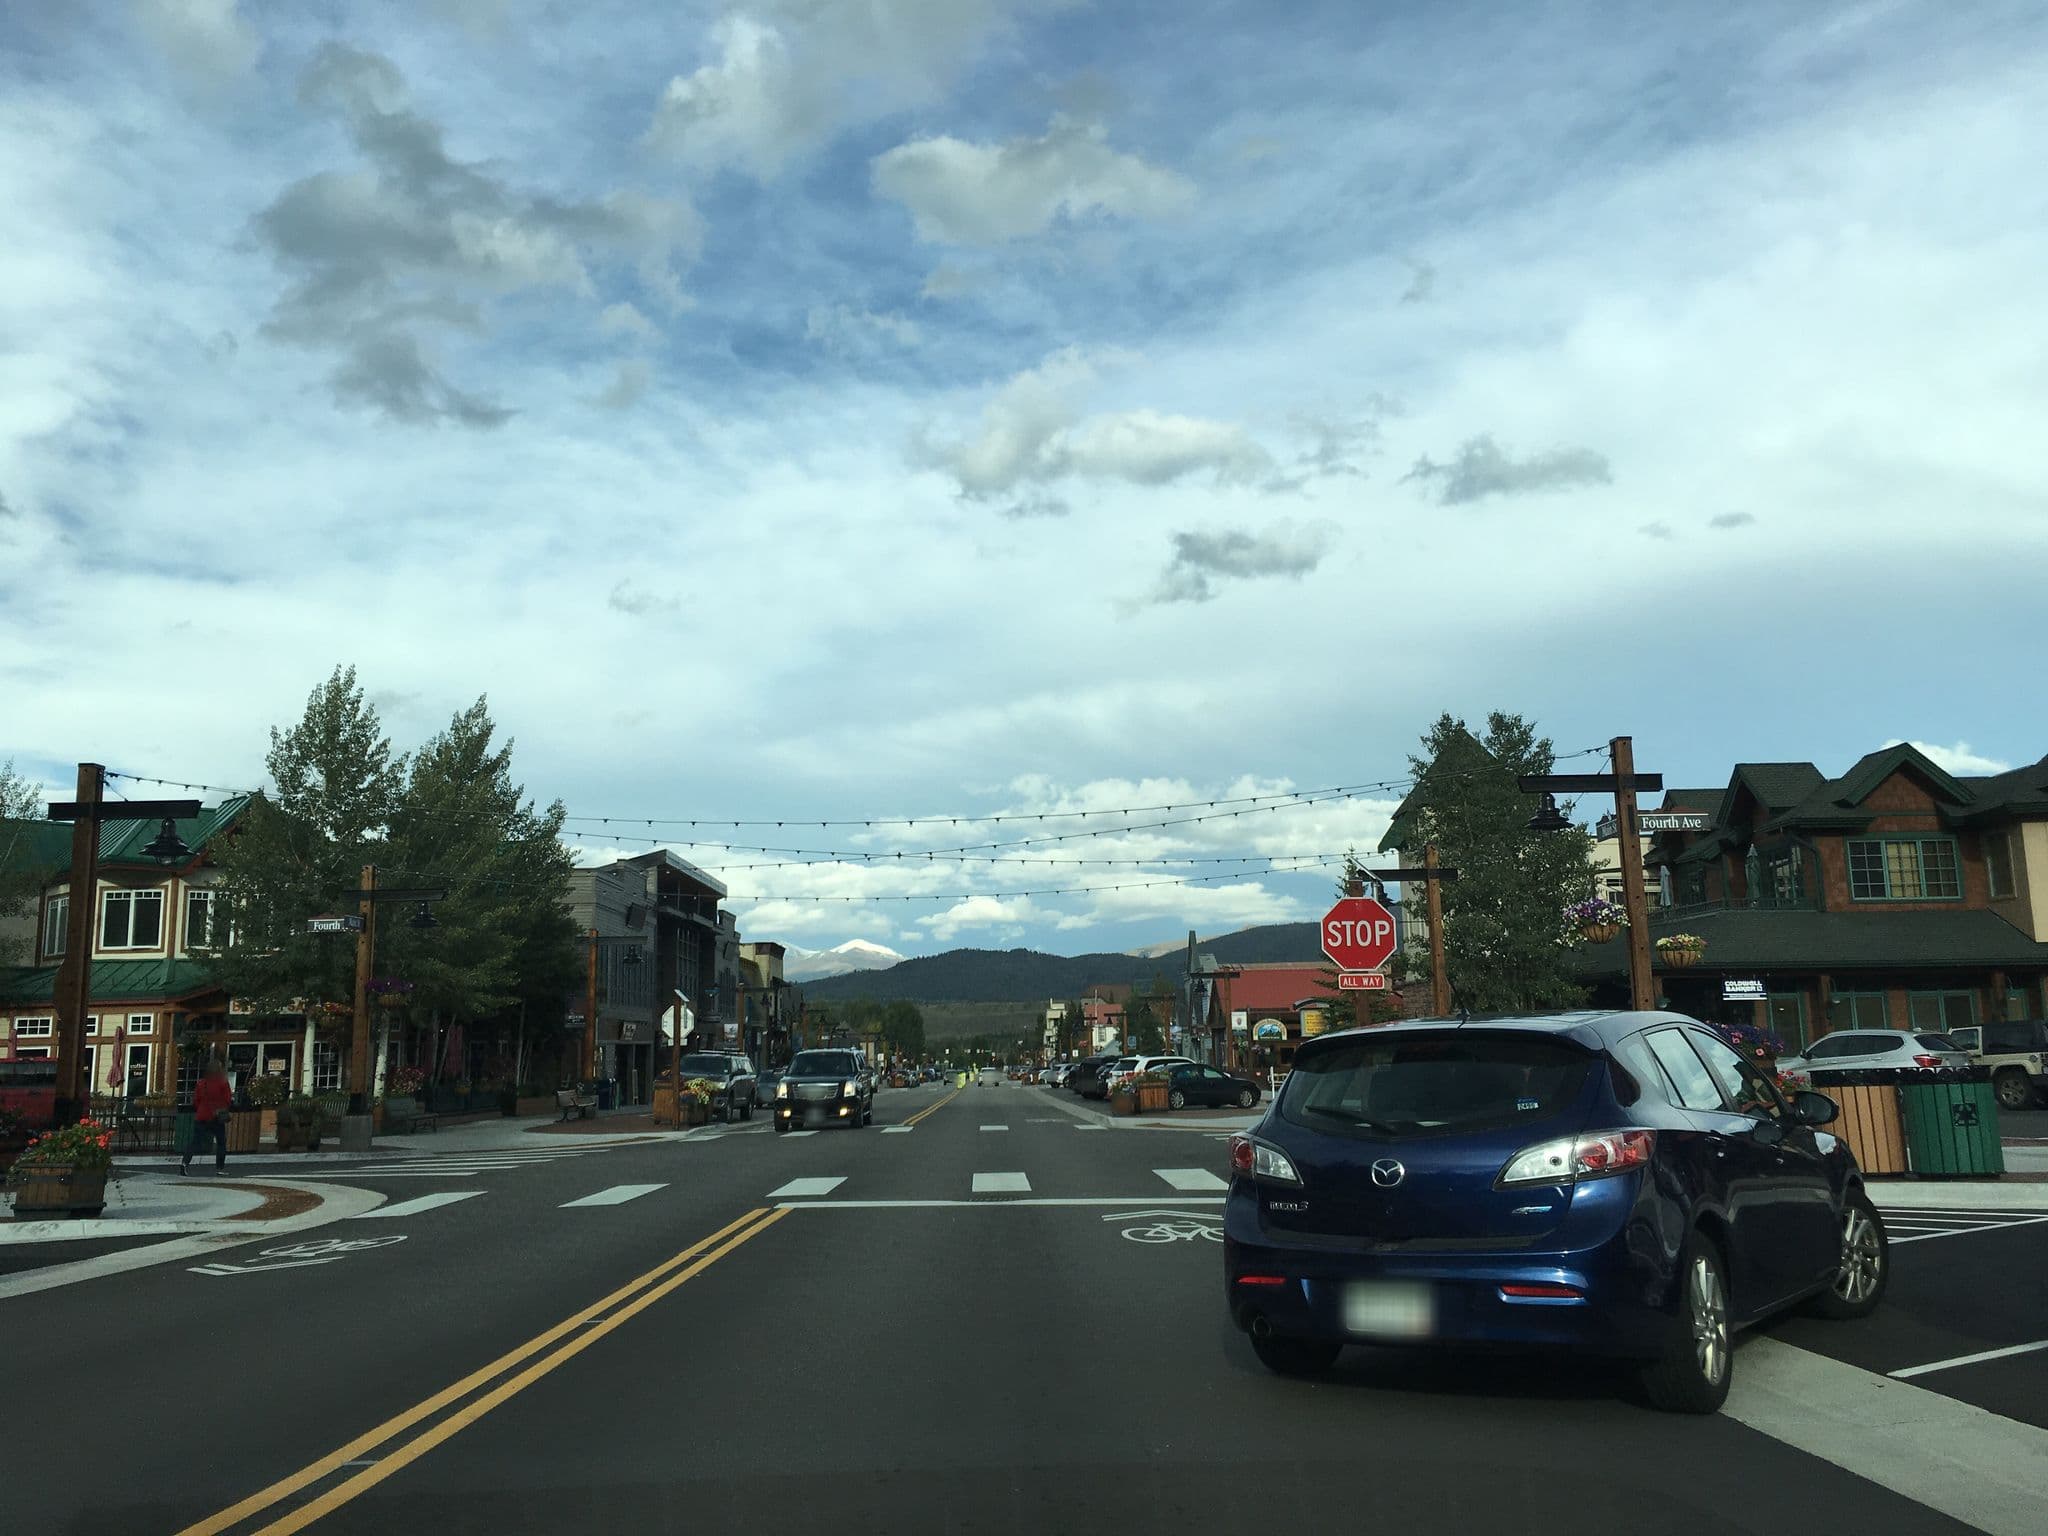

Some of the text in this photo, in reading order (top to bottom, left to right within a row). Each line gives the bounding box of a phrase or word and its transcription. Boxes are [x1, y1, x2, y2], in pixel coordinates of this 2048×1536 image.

[1642, 816, 1702, 829] Fourth Ave
[313, 920, 340, 930] Fourth
[1327, 920, 1390, 947] STOP
[1343, 976, 1380, 986] ALL WAY
